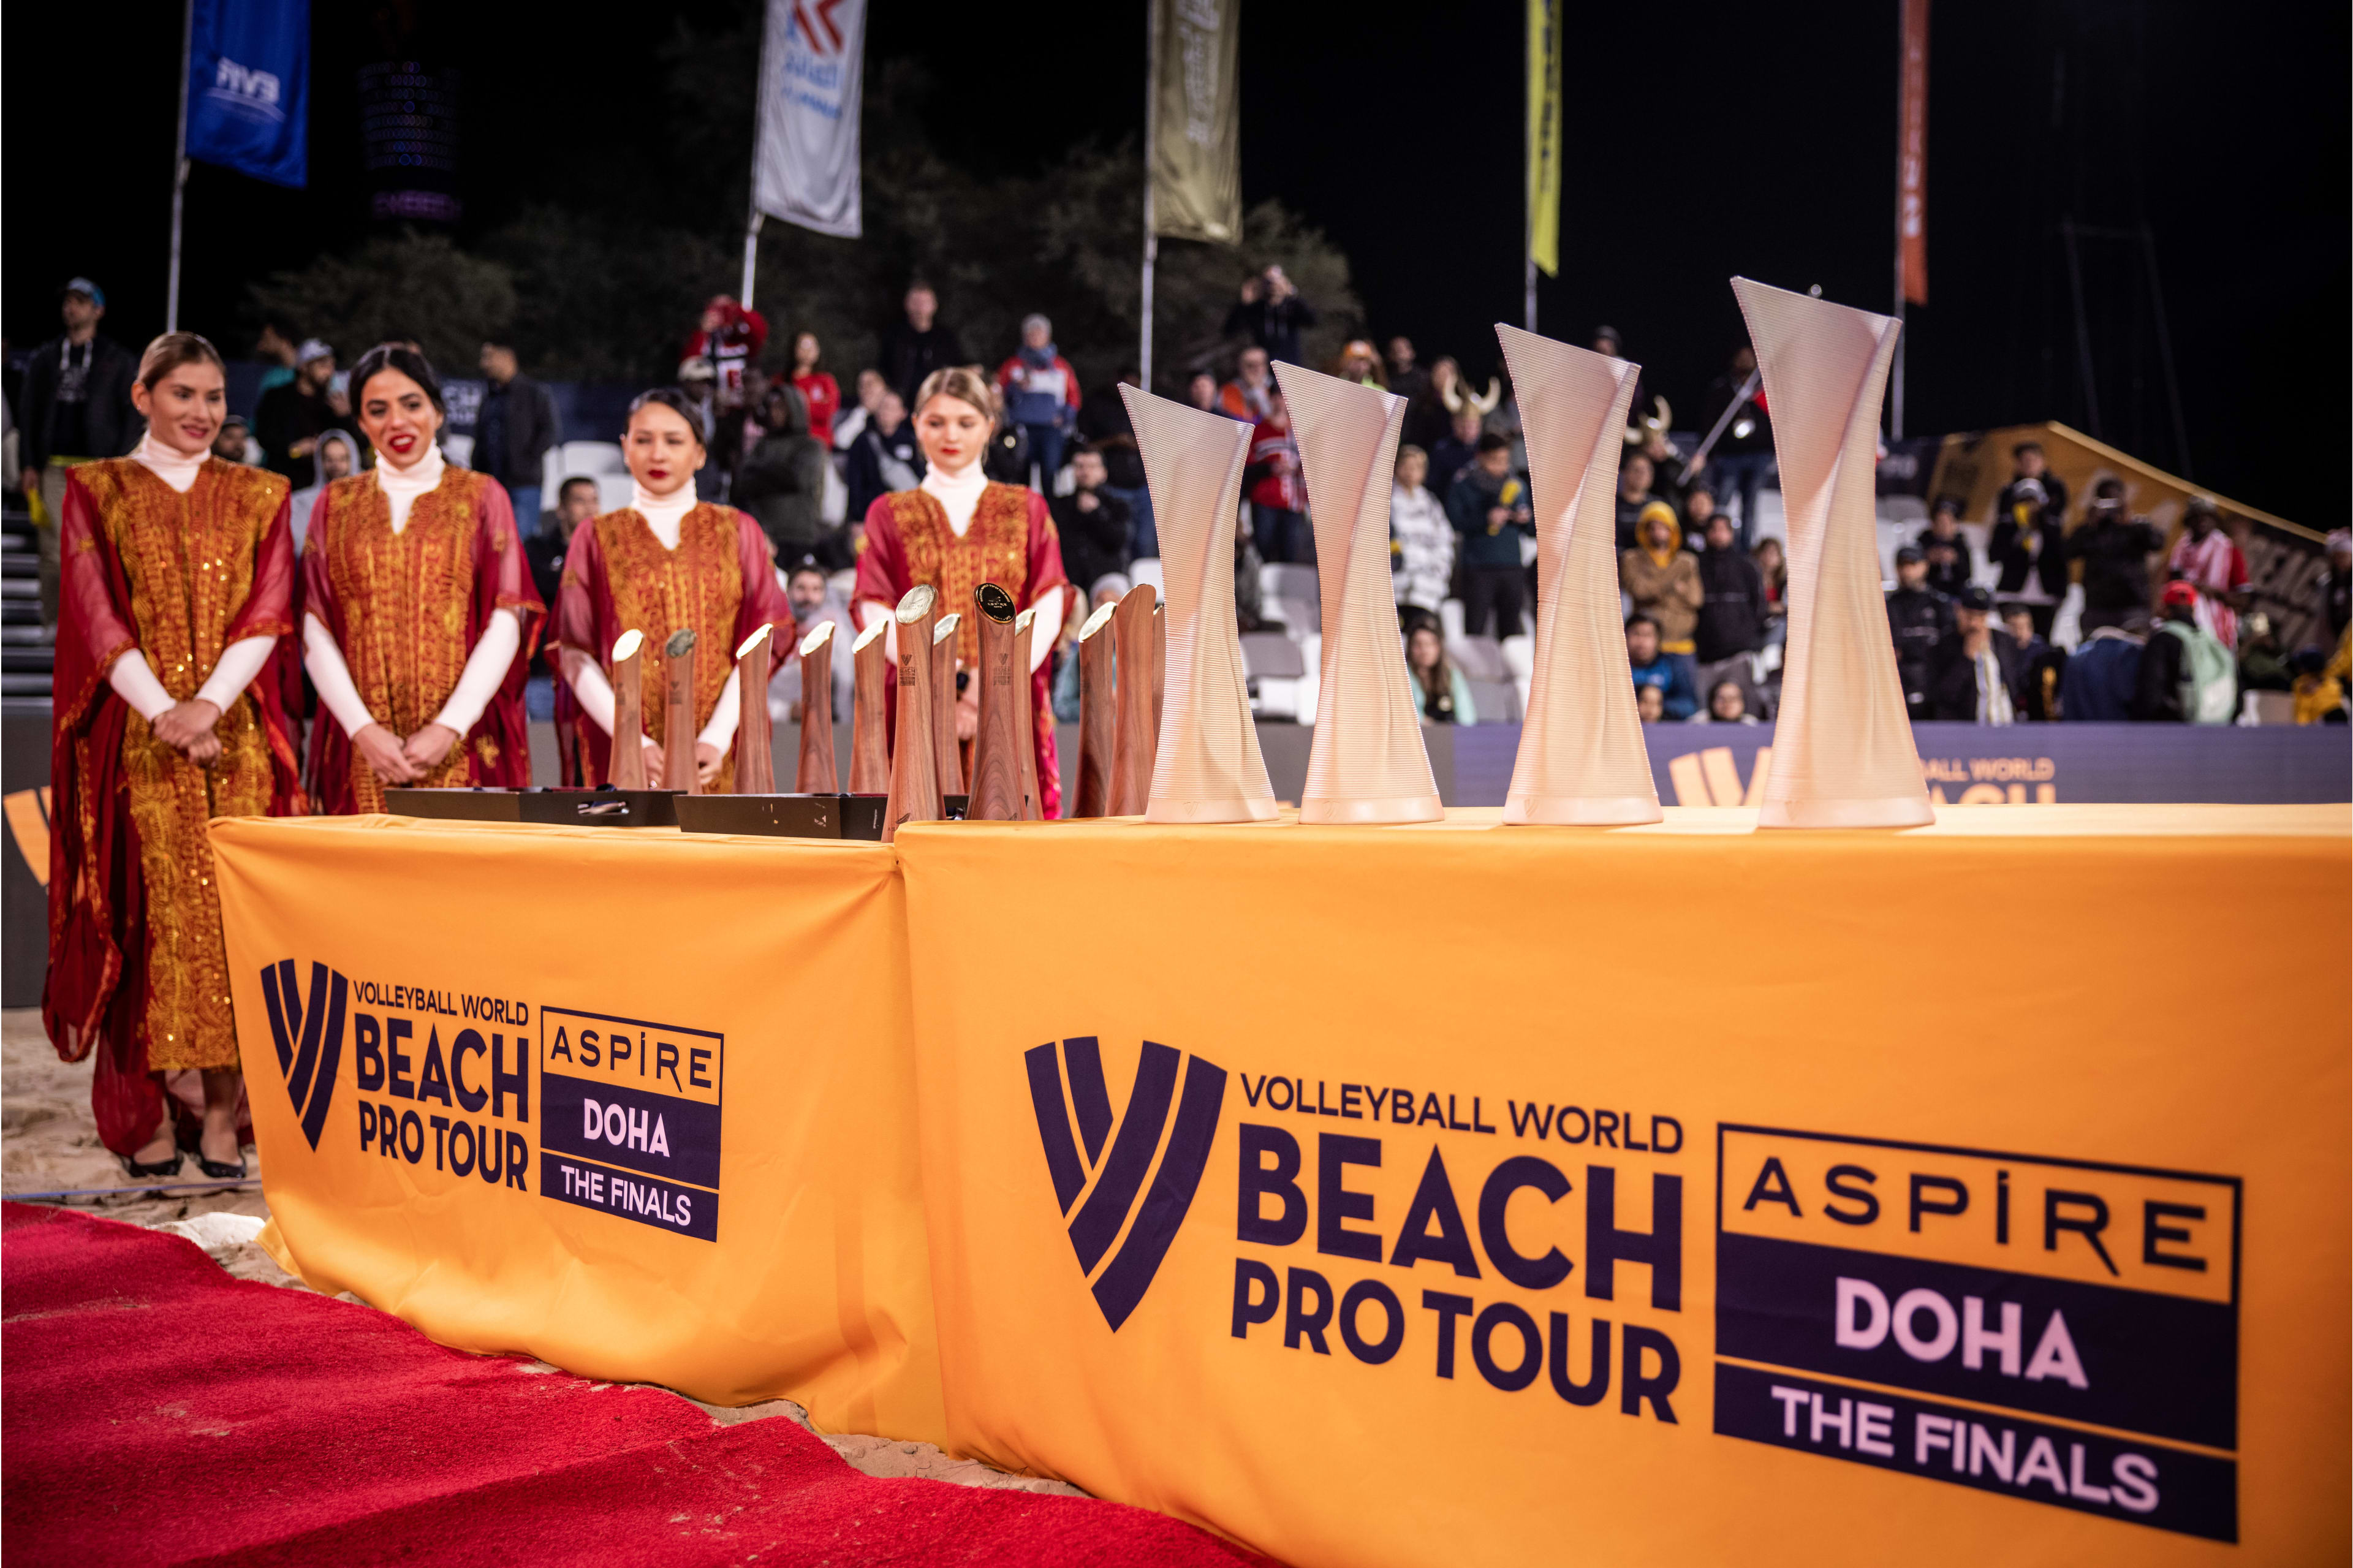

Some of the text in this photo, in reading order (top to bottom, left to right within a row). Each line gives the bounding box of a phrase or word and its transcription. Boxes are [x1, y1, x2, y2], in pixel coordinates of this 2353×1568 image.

[1969, 757, 2055, 781] WORLD
[354, 982, 528, 1025] VOLLEYBALL WORLD
[355, 1013, 528, 1122] BEACH
[359, 1100, 528, 1191] PRO TOUR
[585, 1099, 669, 1157] DOHA
[1241, 1074, 1682, 1153] VOLLEYBALL WORLD
[562, 1165, 690, 1225] THE FINALS
[1238, 1124, 1681, 1311] BEACH
[1232, 1259, 1680, 1424] PRO TOUR
[1836, 1278, 2086, 1386] DOHA
[1772, 1387, 2156, 1509] THE FINALS
